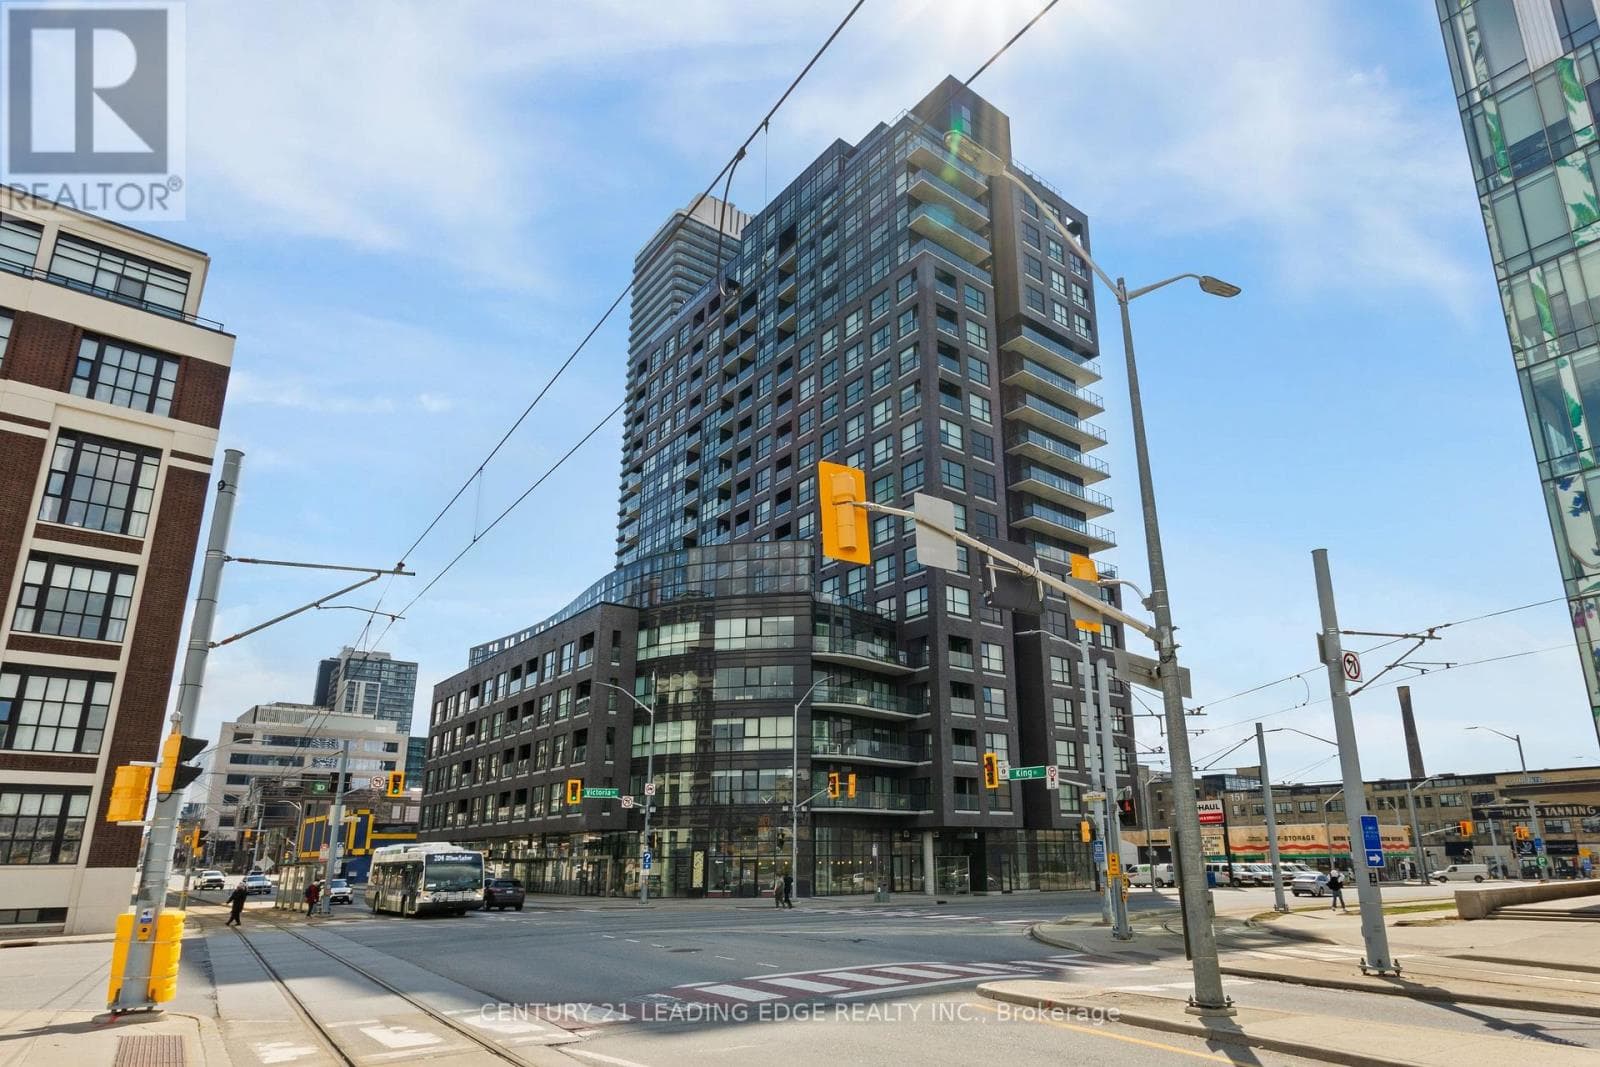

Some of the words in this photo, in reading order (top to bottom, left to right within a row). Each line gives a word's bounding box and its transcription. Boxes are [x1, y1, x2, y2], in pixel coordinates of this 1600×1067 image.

[1015, 769, 1033, 778] King
[1544, 805, 1596, 816] TANNING
[1265, 834, 1316, 843] SF-STORAGE
